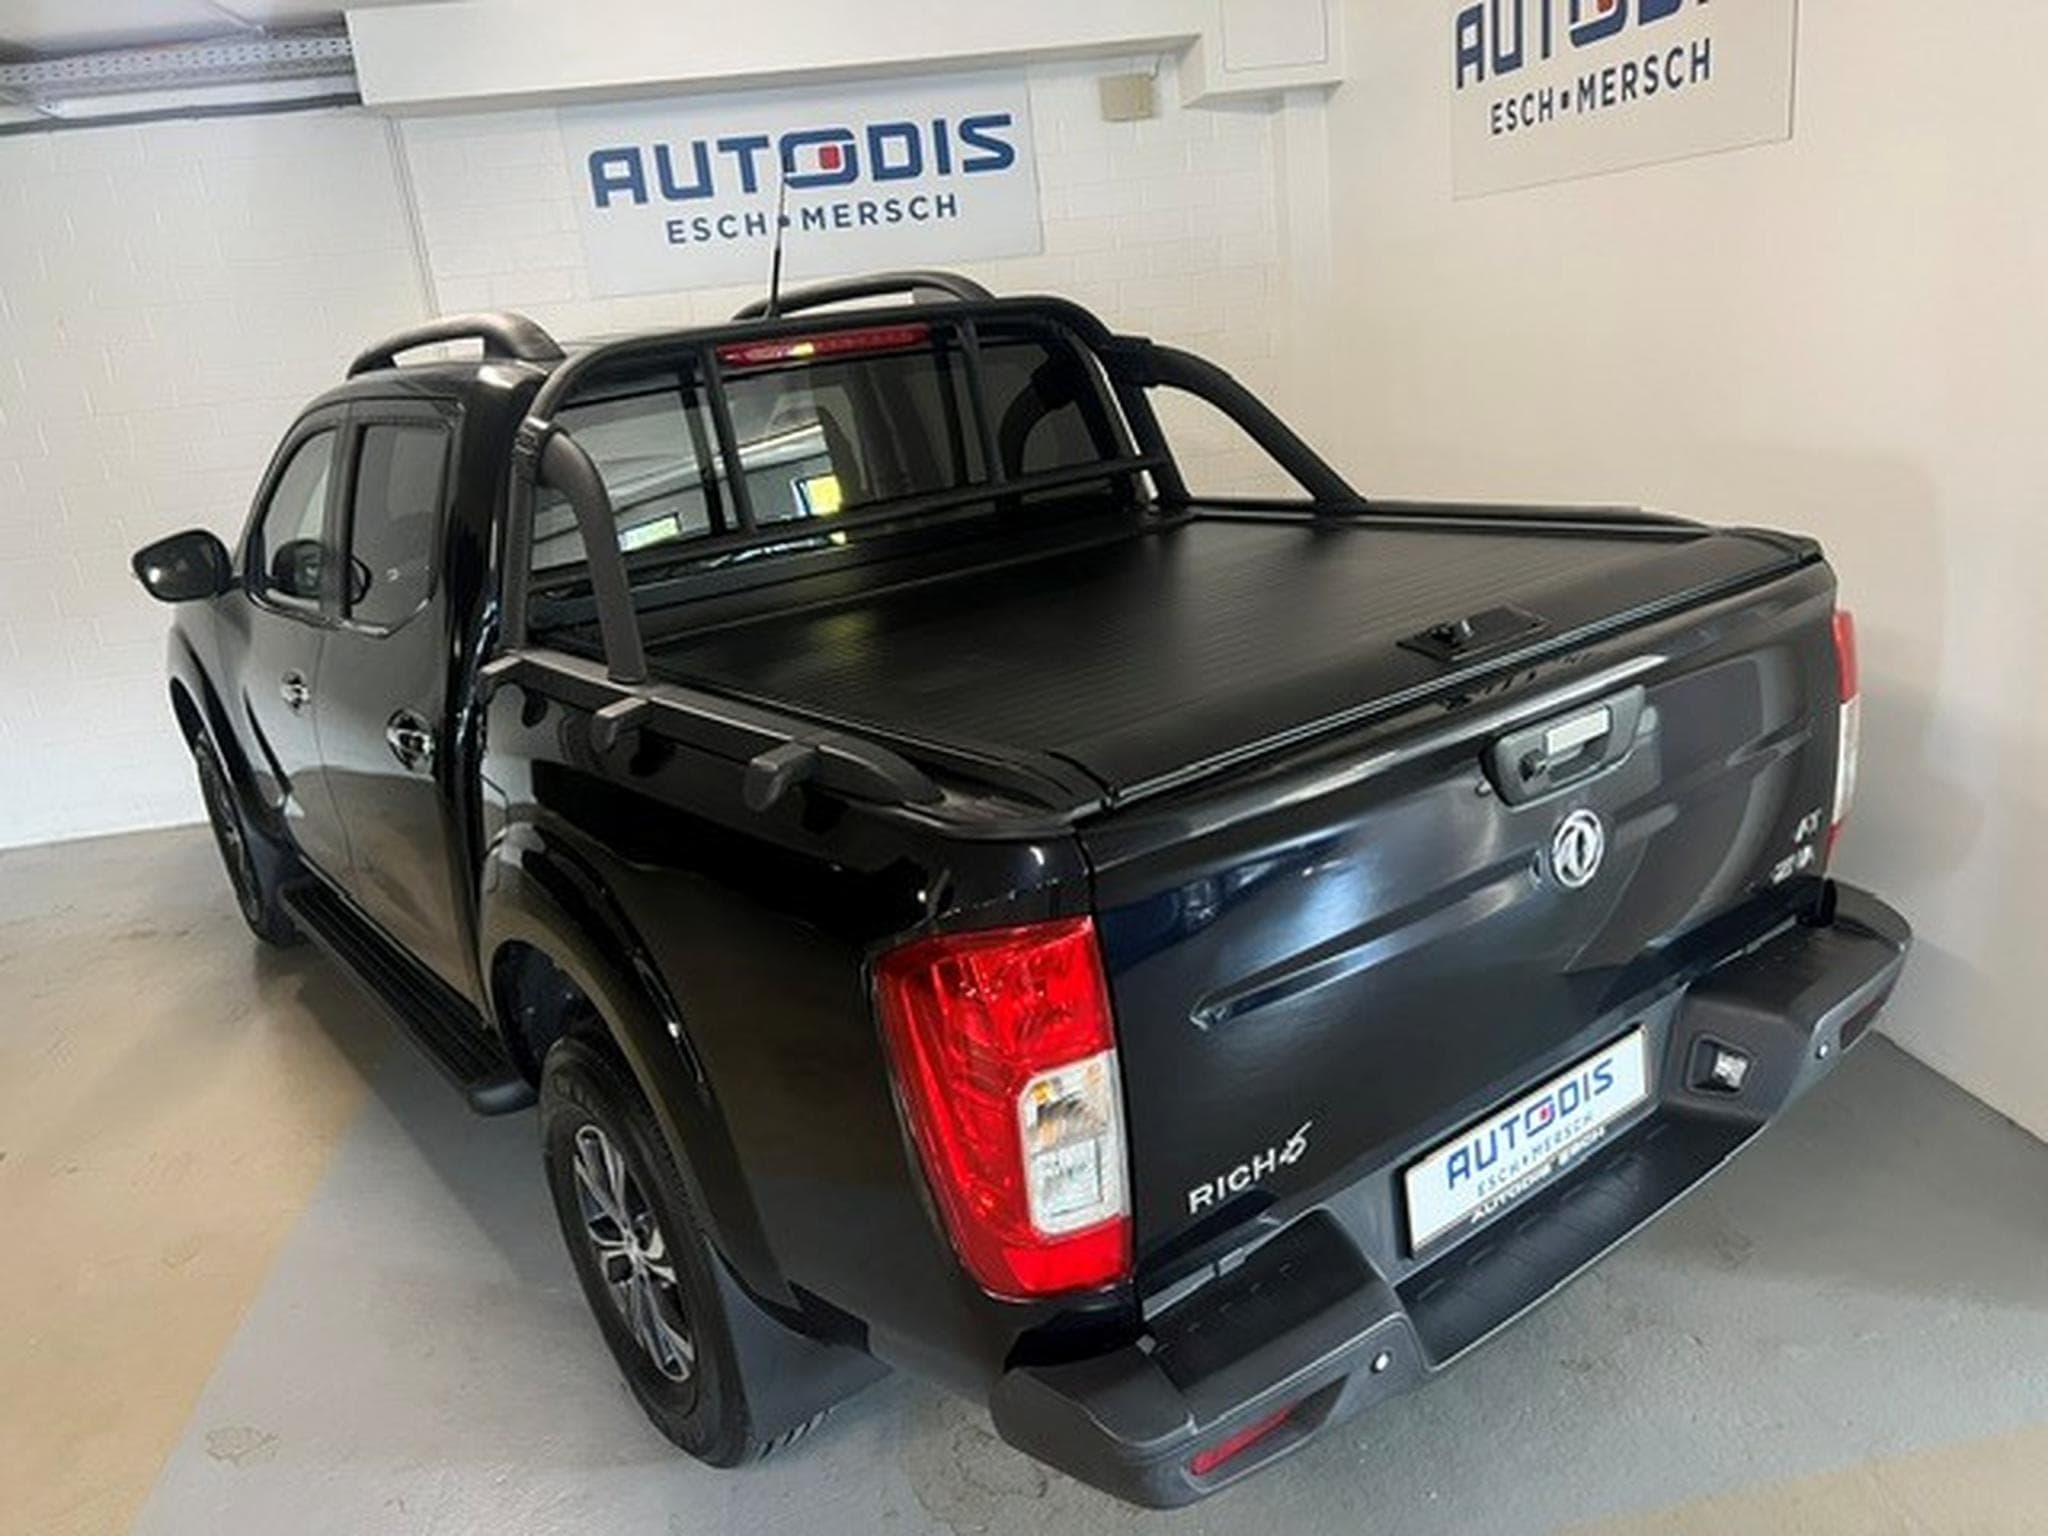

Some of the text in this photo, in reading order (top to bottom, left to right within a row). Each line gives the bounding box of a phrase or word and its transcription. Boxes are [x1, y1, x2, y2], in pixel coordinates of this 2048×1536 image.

[1490, 38, 1712, 135] ESCH MERSCH
[588, 113, 1017, 208] AUTODIS
[666, 193, 959, 244] ESCH MERSCH
[1446, 1058, 1613, 1190] AUTODIS
